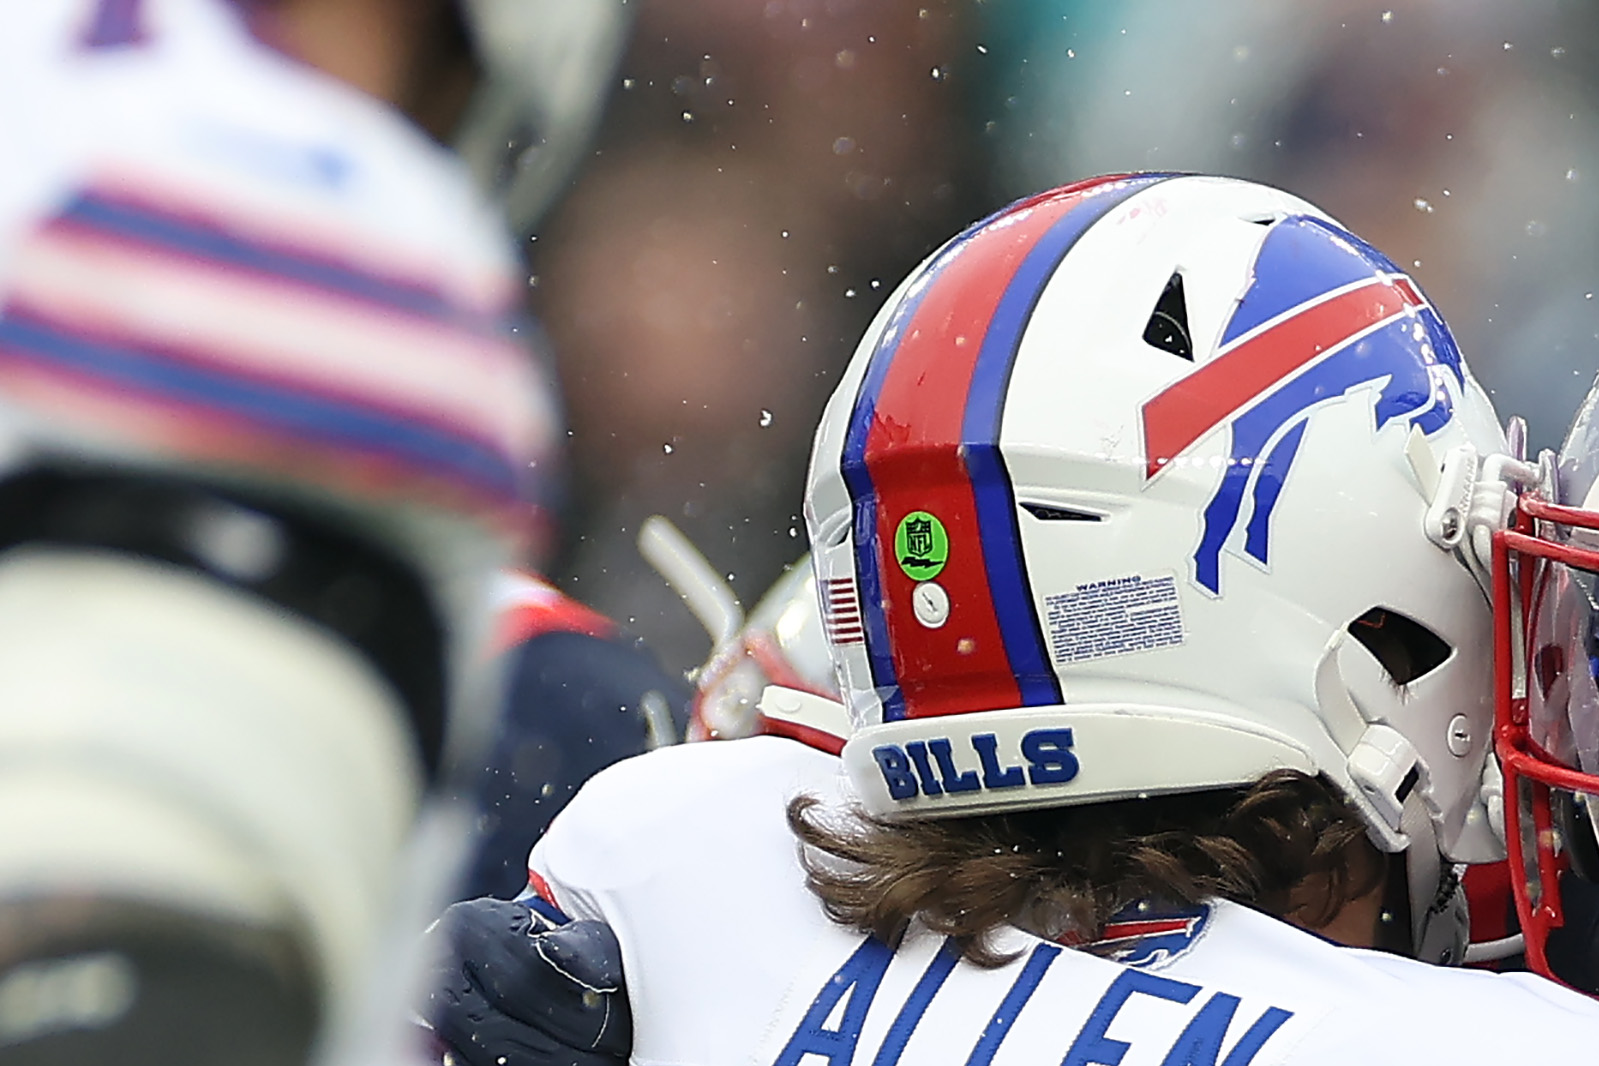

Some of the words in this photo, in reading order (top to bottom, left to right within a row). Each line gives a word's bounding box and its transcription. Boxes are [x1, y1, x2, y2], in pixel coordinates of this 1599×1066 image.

[908, 534, 931, 552] NFL
[1076, 575, 1142, 591] WARNING
[872, 727, 1080, 801] BILLS
